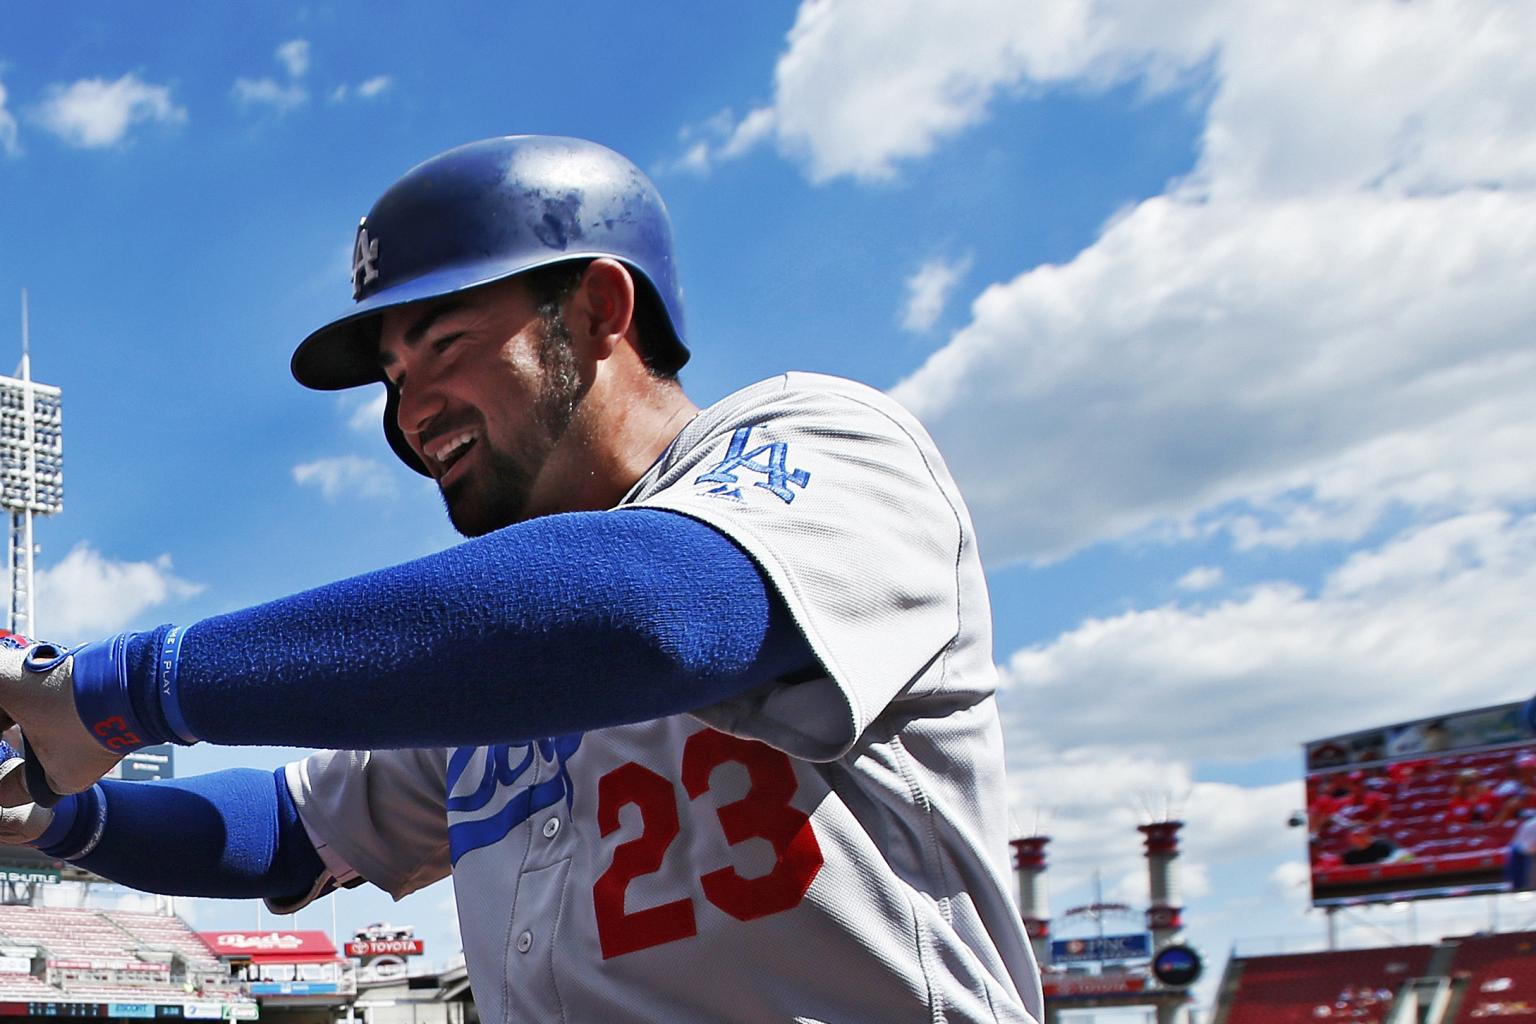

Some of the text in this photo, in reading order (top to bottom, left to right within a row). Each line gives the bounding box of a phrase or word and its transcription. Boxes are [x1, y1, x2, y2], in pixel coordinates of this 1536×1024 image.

[694, 425, 811, 504] LA
[162, 660, 173, 696] PLAY
[593, 726, 825, 960] 23
[9, 872, 57, 884] SHUTTLE
[371, 941, 416, 952] TOYOTA
